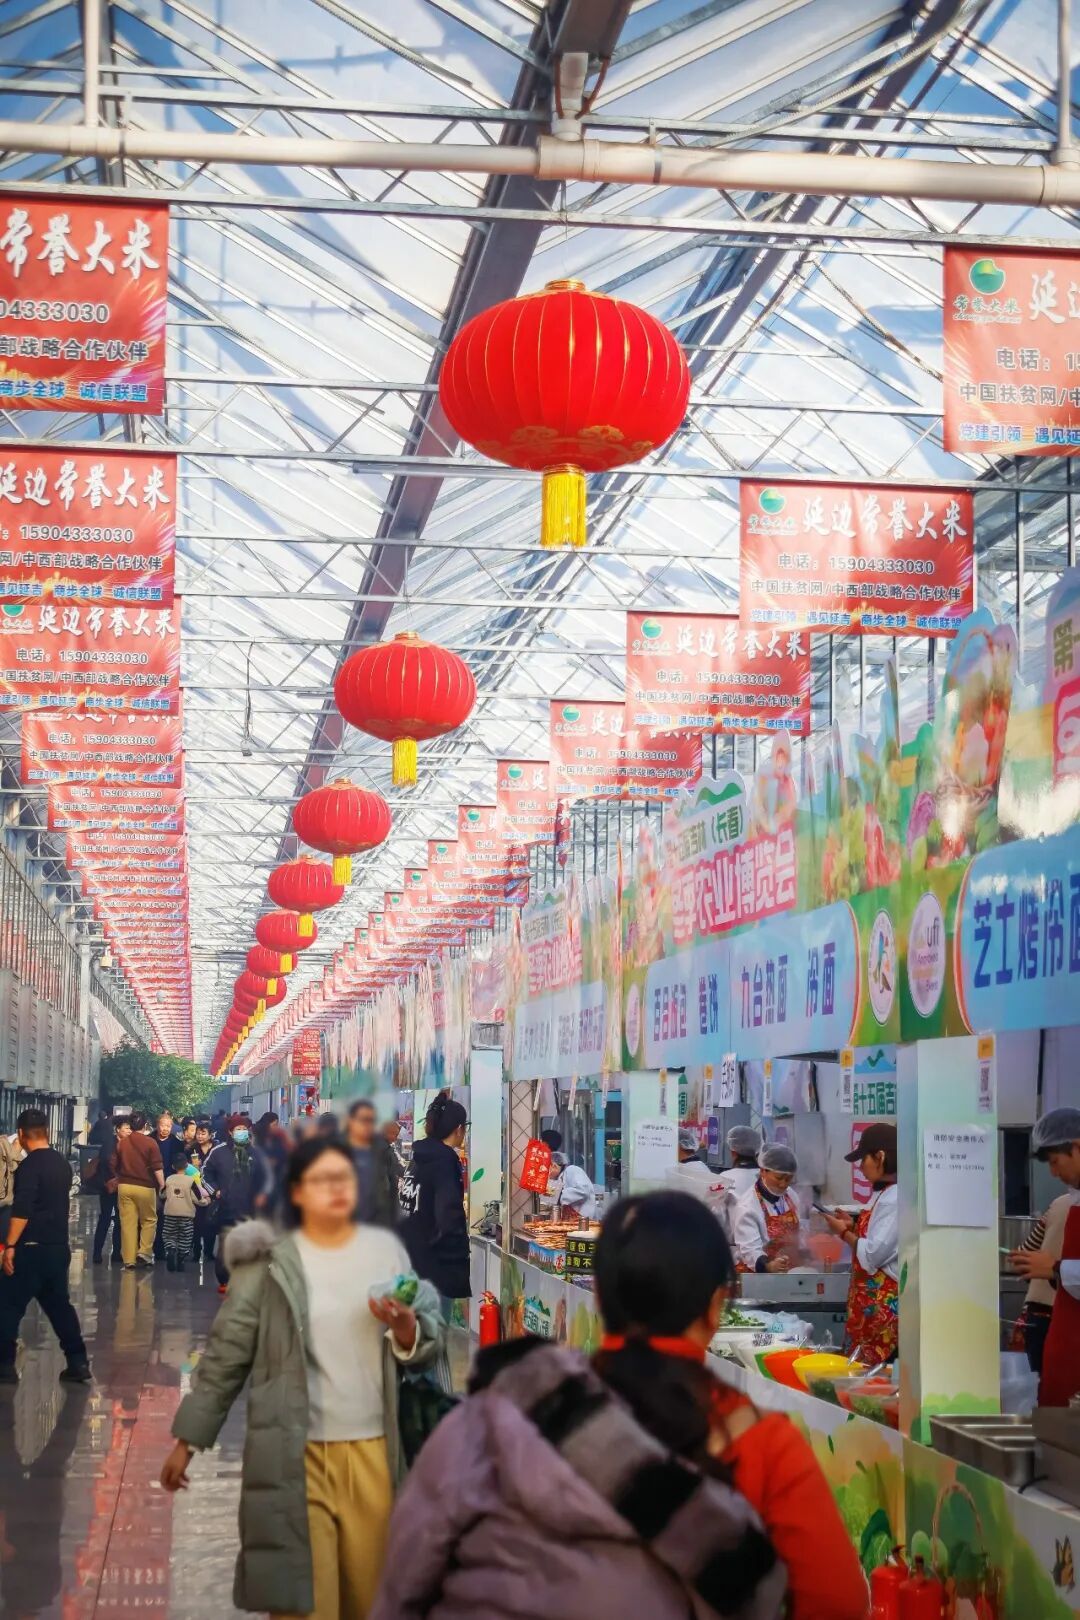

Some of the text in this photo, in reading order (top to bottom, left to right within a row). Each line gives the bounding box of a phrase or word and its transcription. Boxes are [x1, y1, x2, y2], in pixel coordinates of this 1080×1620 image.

[80, 381, 147, 402] 诚信联盟
[960, 424, 1022, 442] 党建引领
[803, 494, 968, 543] 延边常誉大米
[20, 525, 134, 542] 15904333030
[829, 555, 934, 573] 15904333030
[113, 587, 162, 600] 诚信联盟
[751, 579, 962, 601] 中国扶贫网/中西部战略合作伙伴
[59, 650, 148, 664] 15904333030
[696, 671, 781, 686] 15904333030
[84, 735, 156, 746] 15904333030
